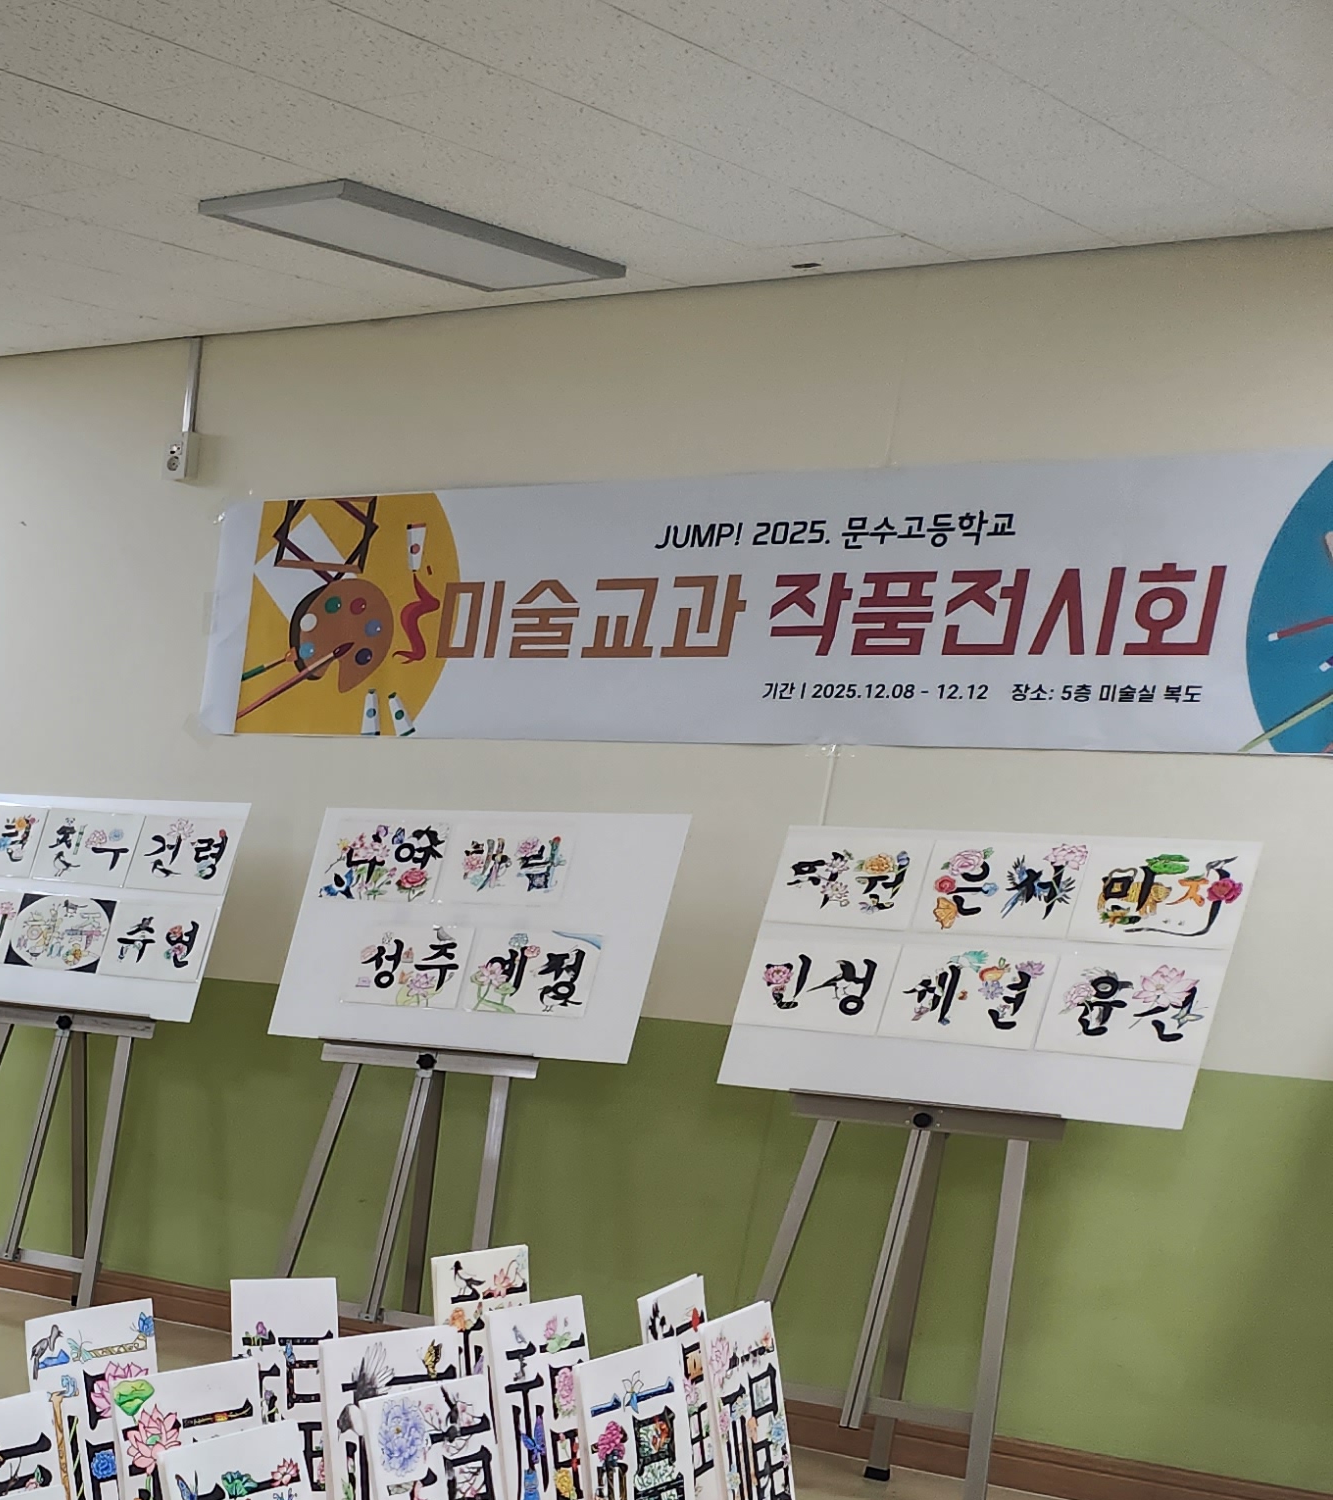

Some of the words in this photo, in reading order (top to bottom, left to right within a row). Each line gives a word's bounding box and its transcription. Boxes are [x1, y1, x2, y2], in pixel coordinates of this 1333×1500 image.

[655, 522, 742, 549] JUMP!
[752, 520, 831, 547] 2025.
[841, 510, 1017, 550] 문수고등학교
[439, 571, 747, 660] 미술교과
[769, 562, 1229, 657] 작품전시회
[761, 681, 796, 701] 기간
[811, 682, 916, 701] 2025.12.08
[936, 682, 990, 701] 12.12
[1010, 683, 1055, 704] 장소:
[1061, 683, 1092, 704] 5층
[1098, 683, 1157, 704] 미술실
[1162, 683, 1204, 704] 복도
